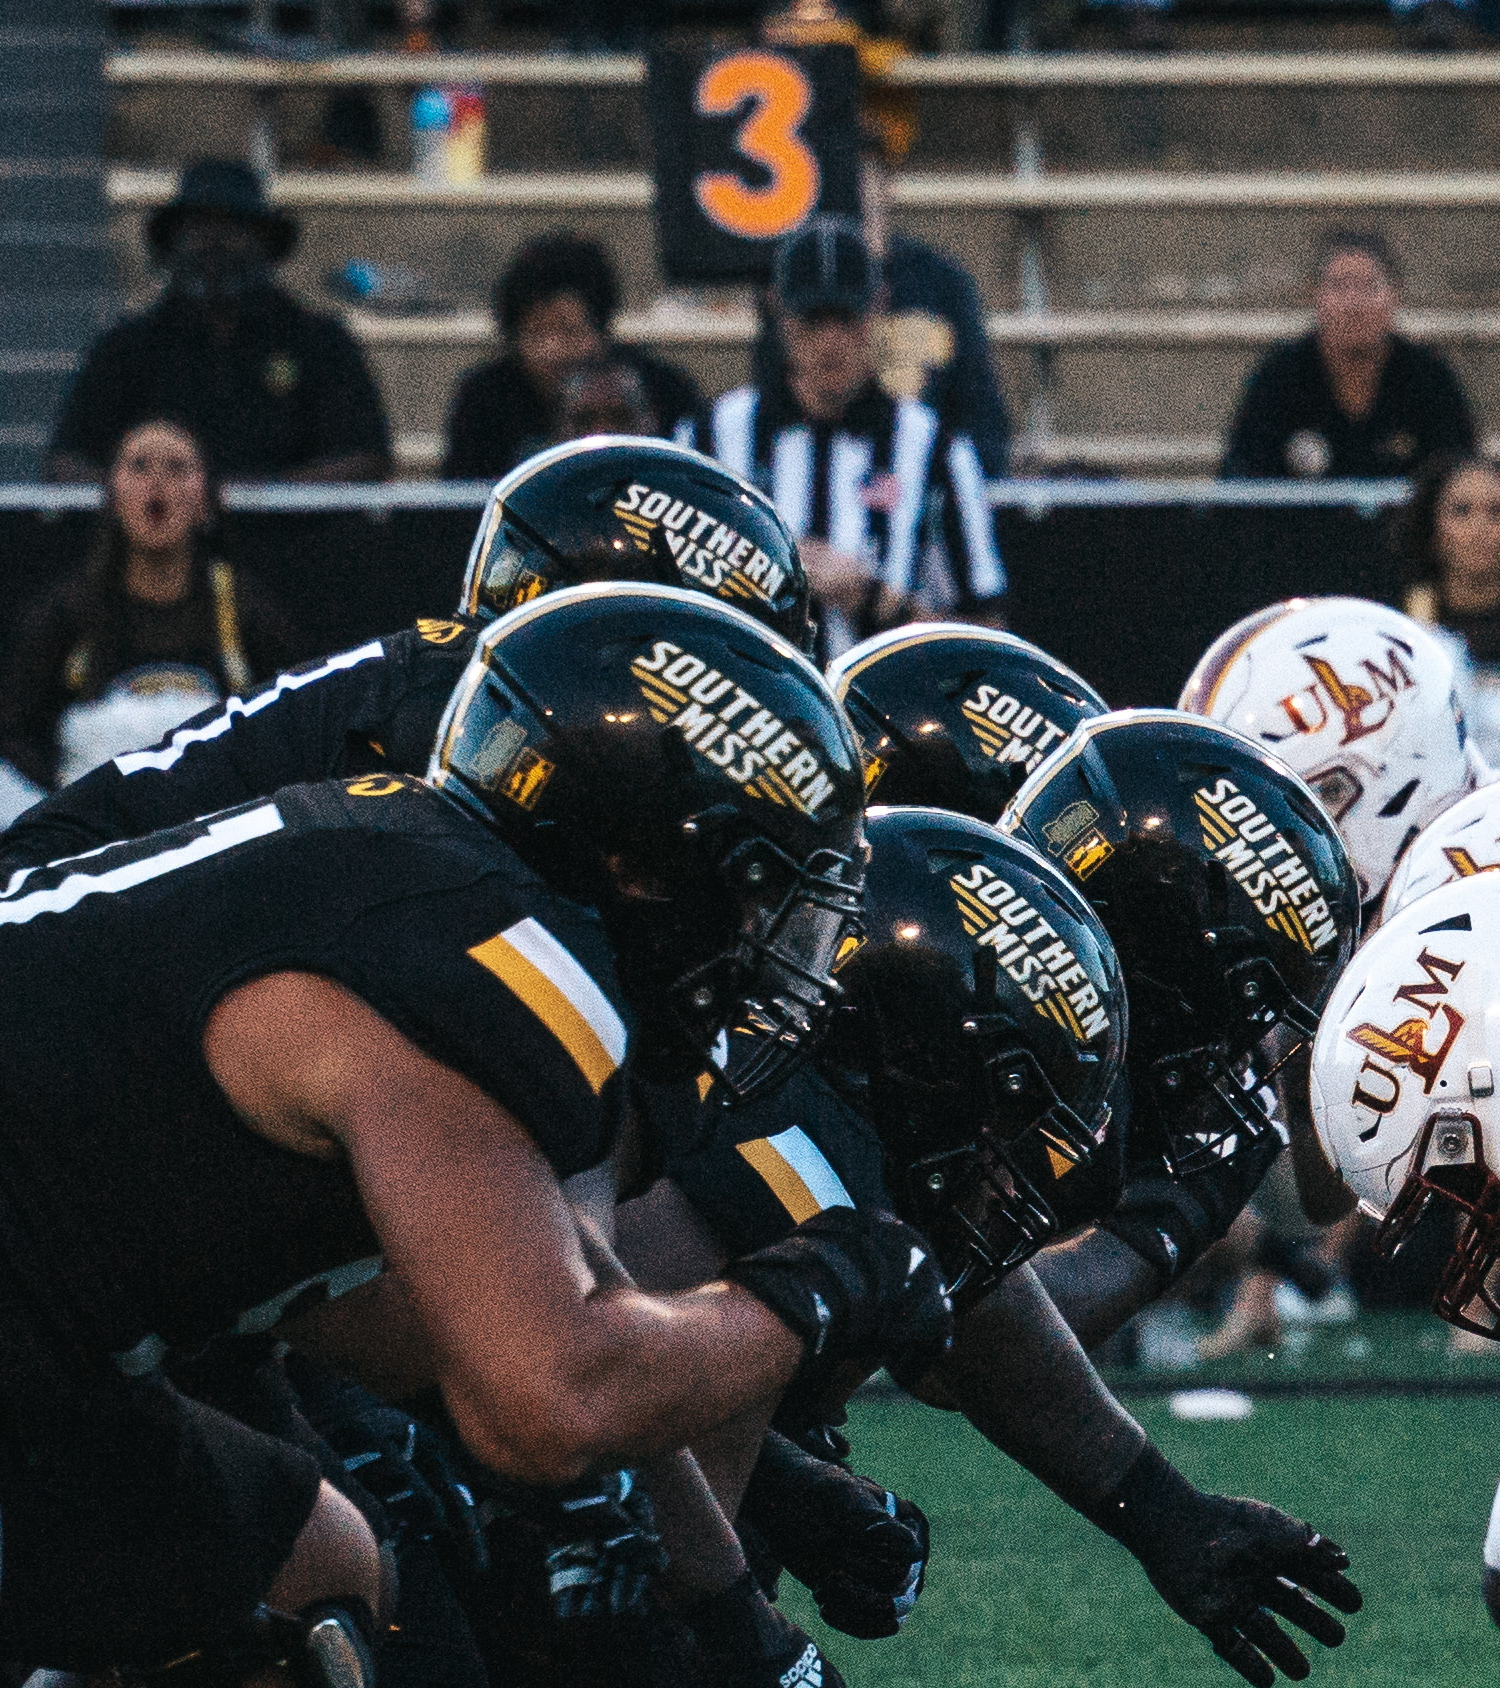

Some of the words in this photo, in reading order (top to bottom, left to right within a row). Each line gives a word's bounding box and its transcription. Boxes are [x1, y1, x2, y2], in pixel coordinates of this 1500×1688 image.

[698, 52, 820, 240] 3
[617, 484, 786, 596] SOUTHERN
[664, 528, 732, 590] MISS
[632, 641, 834, 810] SOUTHERN
[673, 702, 766, 784] MISS
[965, 684, 1070, 760] SOUT
[998, 733, 1048, 775] MI
[1200, 777, 1340, 952] SOUTHERN
[1215, 841, 1289, 917] MISS
[952, 864, 1111, 1041] SOUTHERN
[975, 920, 1060, 1004] MISS
